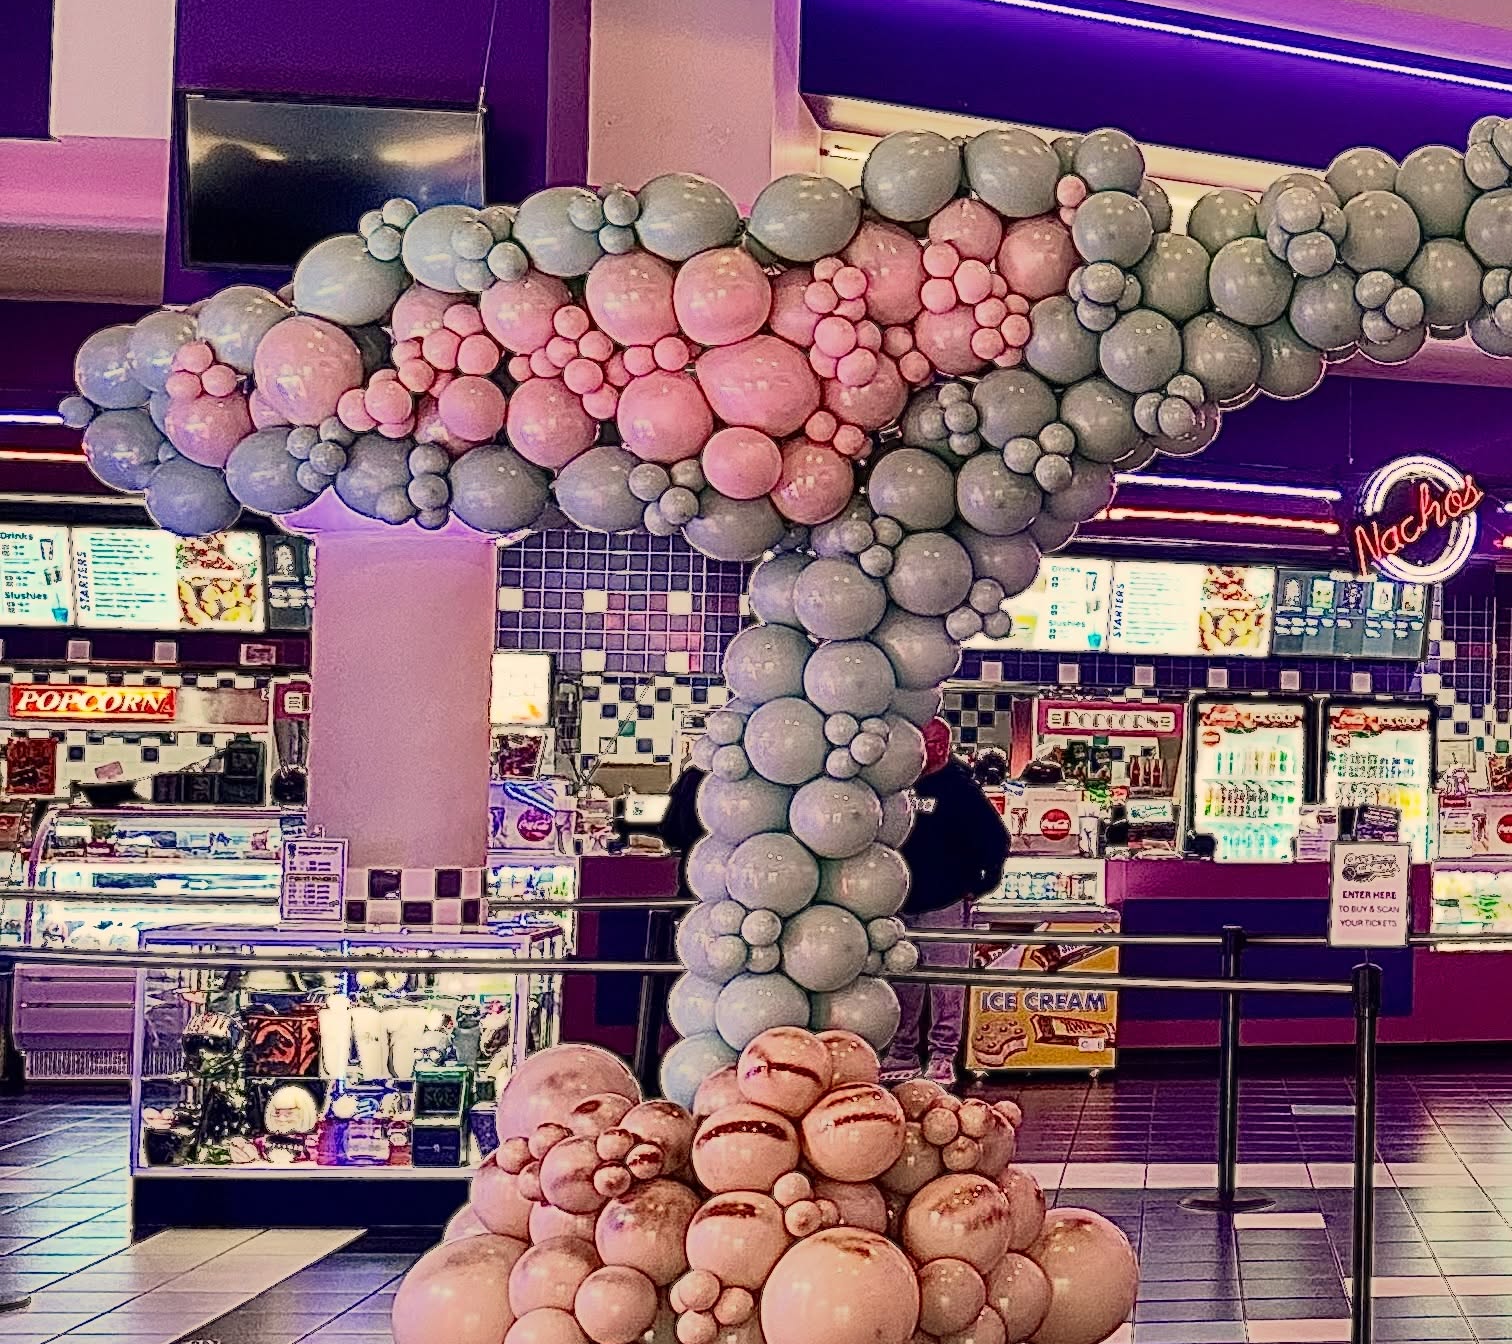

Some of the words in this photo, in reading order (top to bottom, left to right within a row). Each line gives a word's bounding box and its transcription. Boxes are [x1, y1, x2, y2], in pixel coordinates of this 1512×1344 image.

[1355, 474, 1485, 576] Nachos
[15, 690, 167, 713] POPCORN
[1342, 890, 1371, 900] ENTER
[1373, 891, 1397, 900] HERE
[1338, 905, 1349, 913] TO
[1351, 905, 1367, 913] BUY
[1376, 905, 1400, 913] SCAN
[1340, 919, 1364, 927] YOUR
[1366, 919, 1398, 927] TICKETS
[980, 991, 1018, 1013] ICE
[1024, 991, 1108, 1013] CREAM
